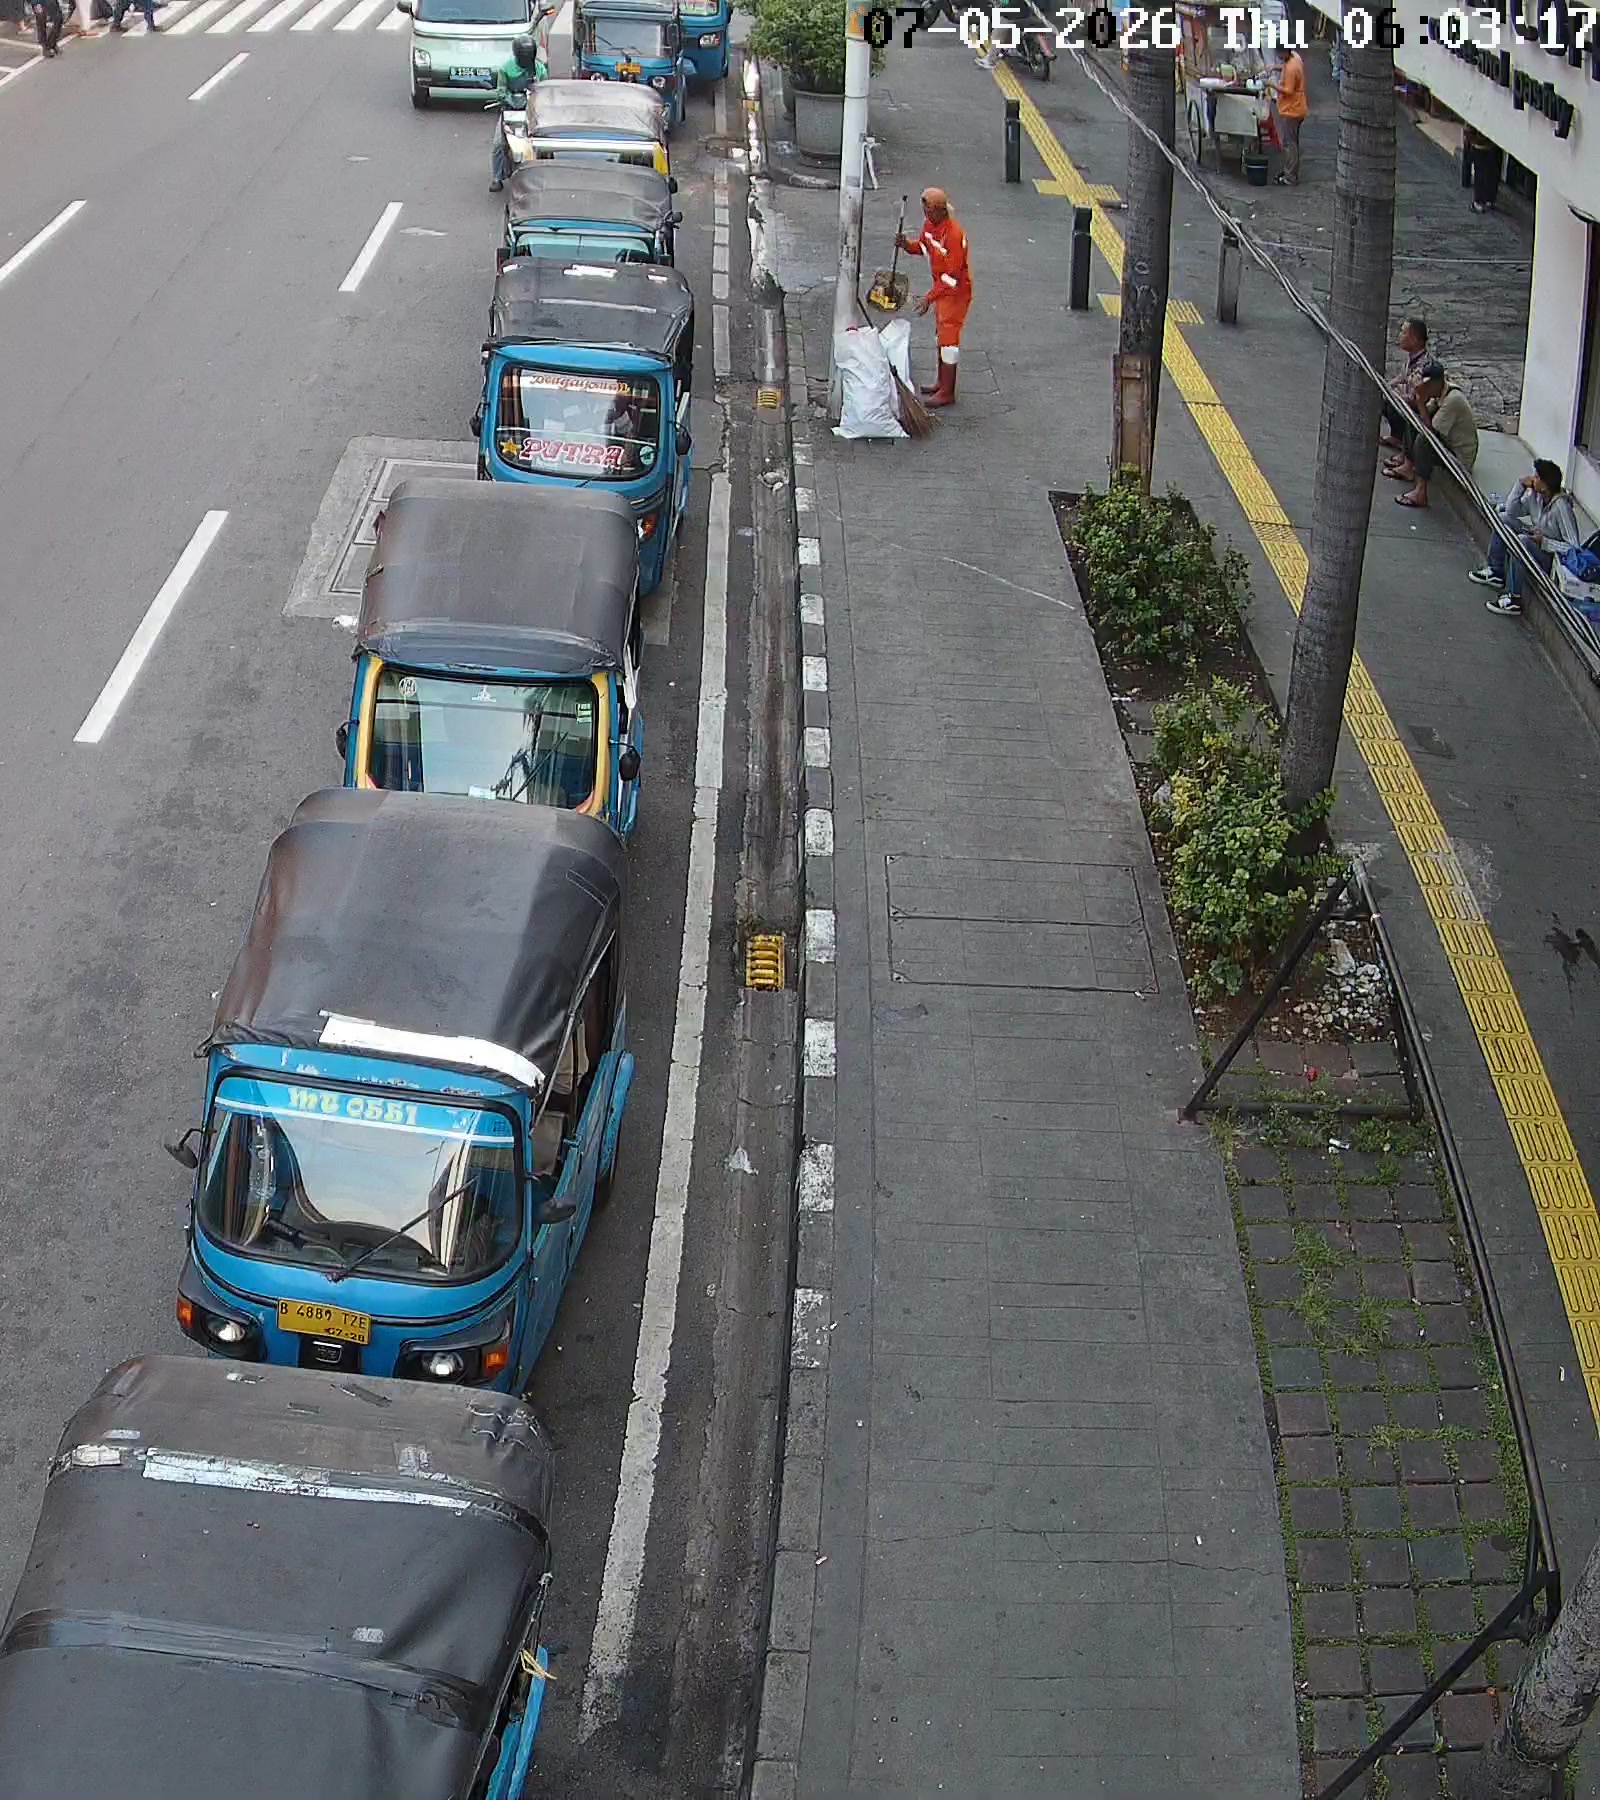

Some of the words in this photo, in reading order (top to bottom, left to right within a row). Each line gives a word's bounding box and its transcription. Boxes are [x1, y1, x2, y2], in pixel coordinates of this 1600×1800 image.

[519, 437, 625, 468] PUTRA
[280, 1301, 289, 1315] B
[341, 1312, 368, 1330] TZE
